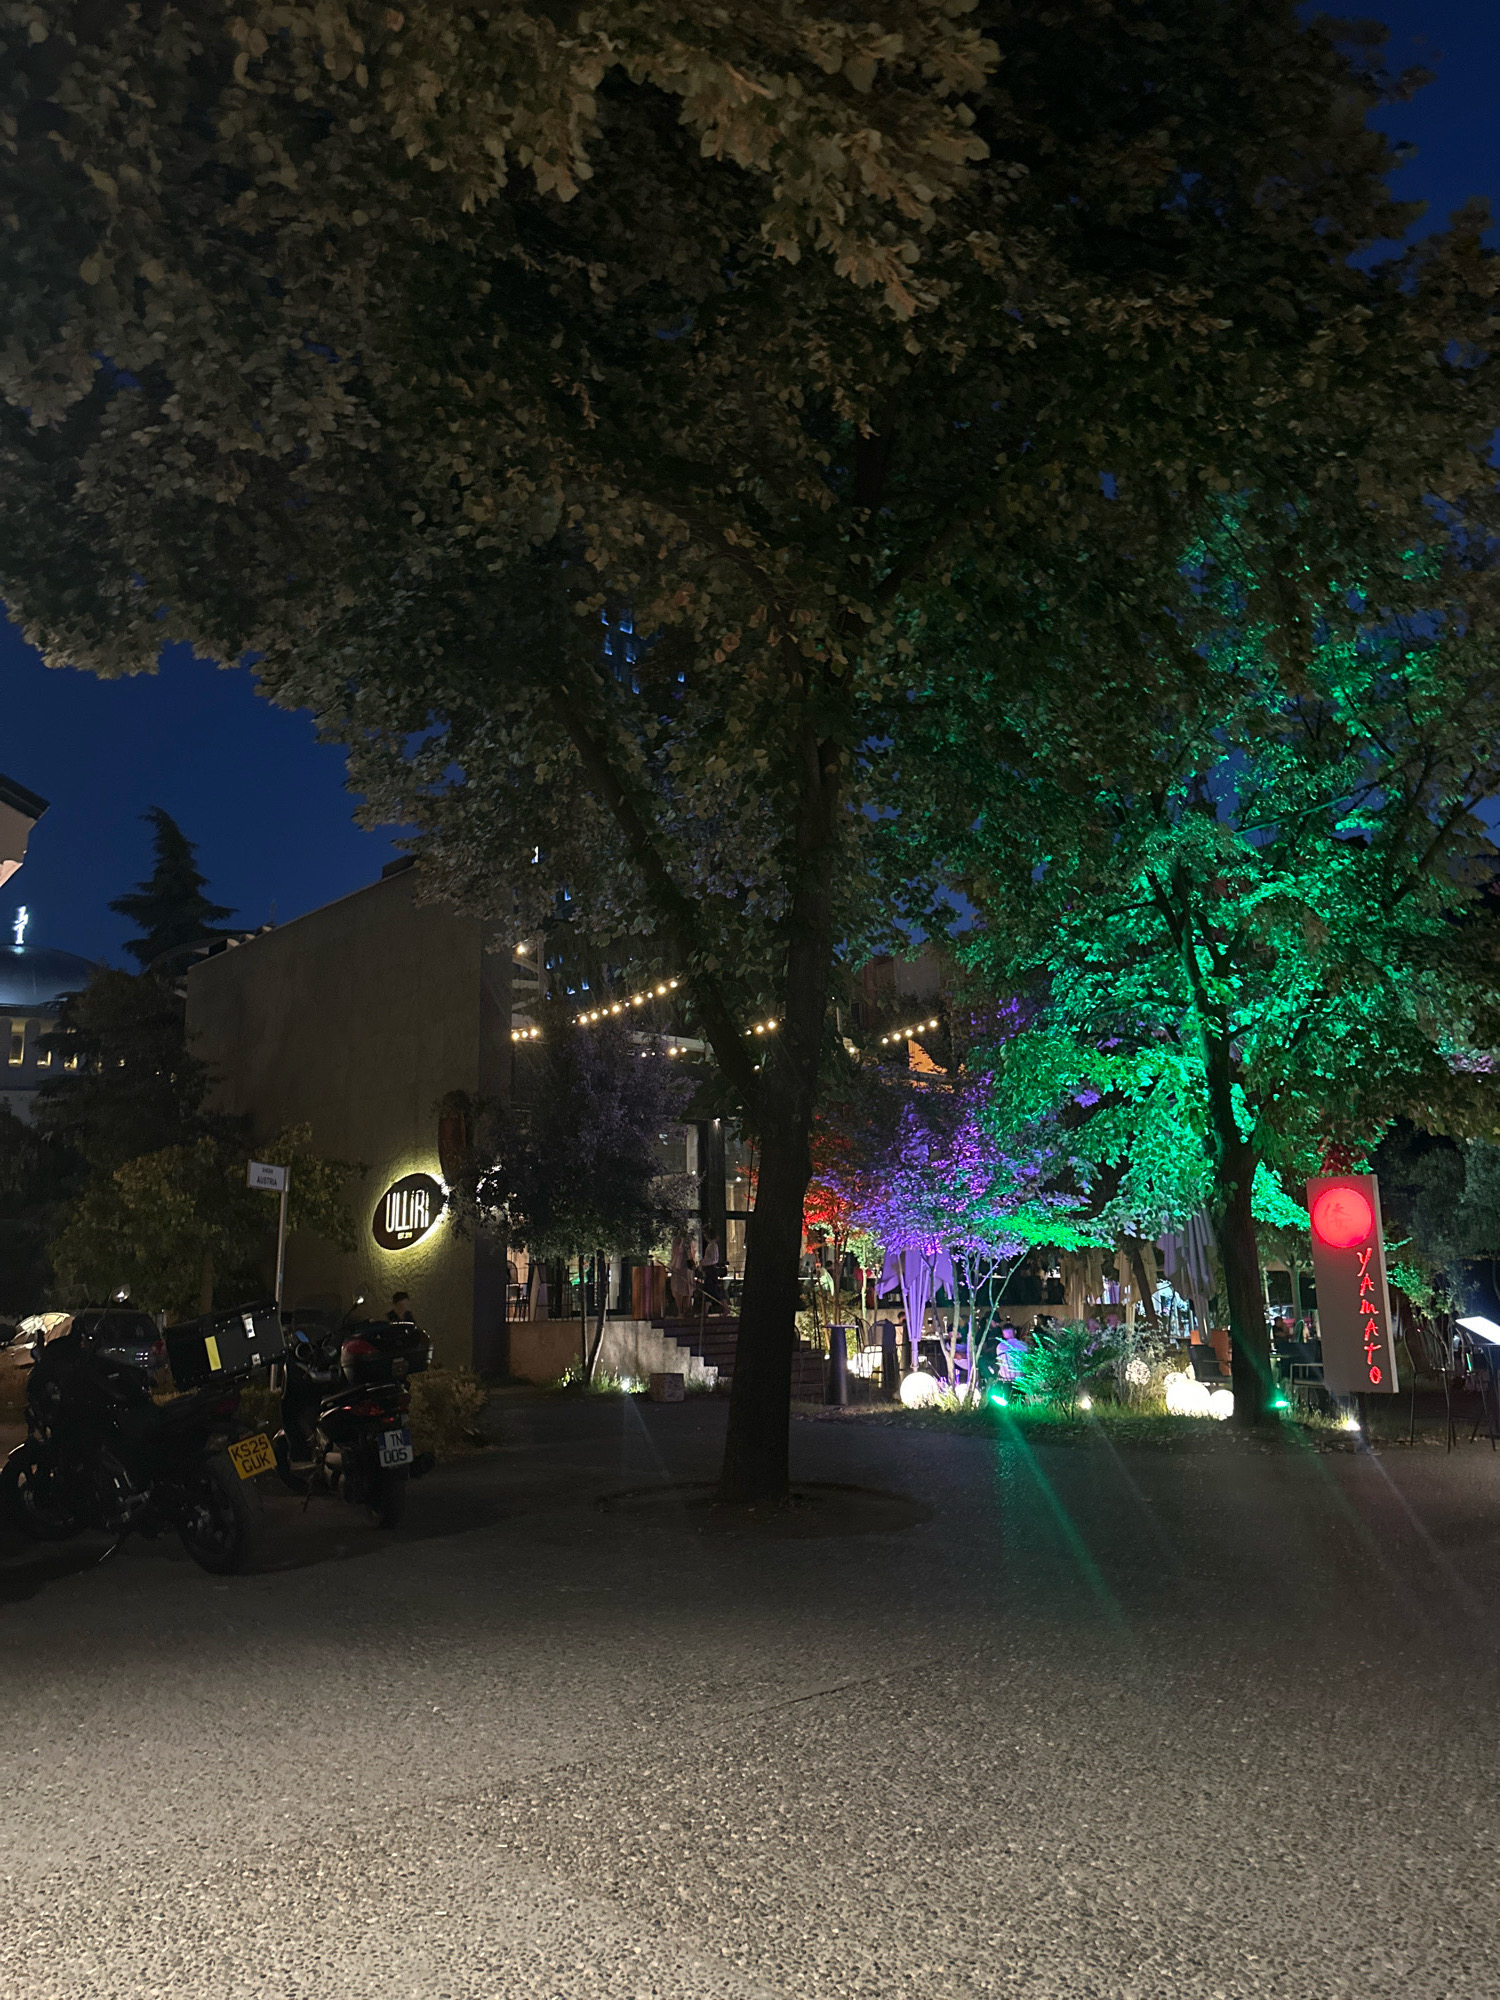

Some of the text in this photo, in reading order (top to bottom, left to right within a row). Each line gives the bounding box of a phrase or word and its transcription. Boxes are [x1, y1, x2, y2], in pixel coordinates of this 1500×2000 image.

[256, 1175, 278, 1186] AUSTRIA
[389, 1431, 403, 1446] TN
[230, 1435, 269, 1461] KS25
[242, 1451, 271, 1473] GUK
